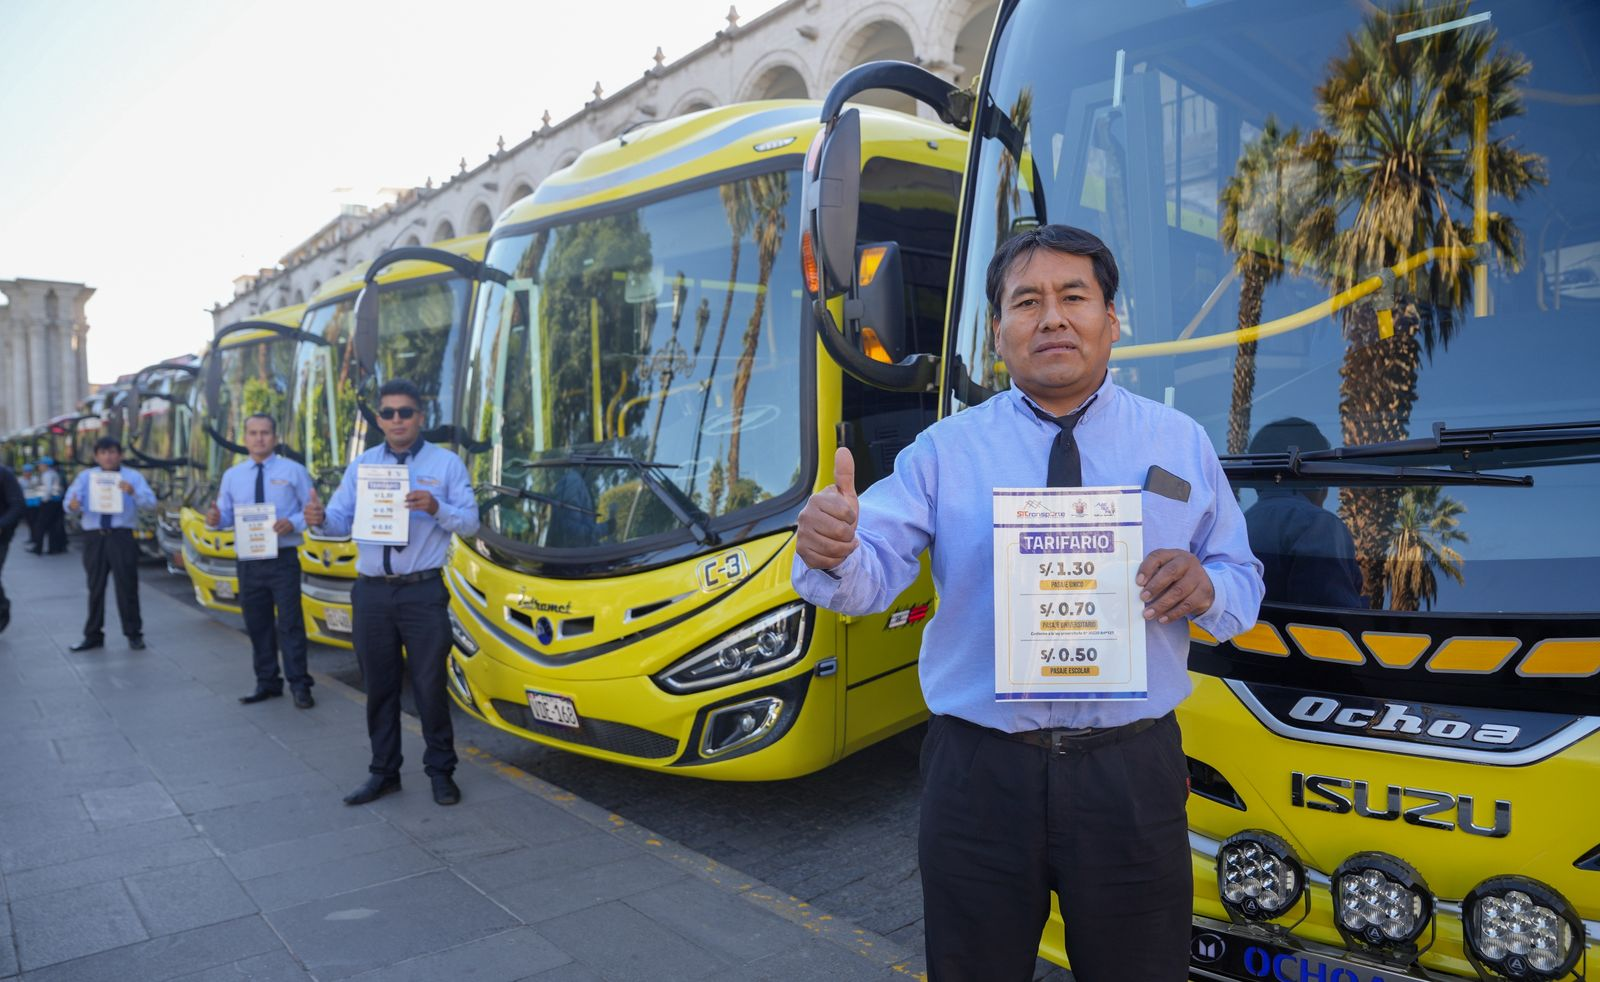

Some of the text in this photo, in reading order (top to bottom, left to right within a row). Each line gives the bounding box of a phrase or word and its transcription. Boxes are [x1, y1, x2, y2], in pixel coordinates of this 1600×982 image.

[1024, 534, 1110, 551] TARIFARIO
[704, 552, 741, 587] C-3
[1057, 561, 1095, 576] 1.30
[1058, 601, 1096, 616] 0.70
[1058, 647, 1098, 662] 0.50
[1050, 667, 1068, 675] PASAJE
[1288, 696, 1521, 745] Ochoa
[1291, 771, 1512, 838] ISUZU
